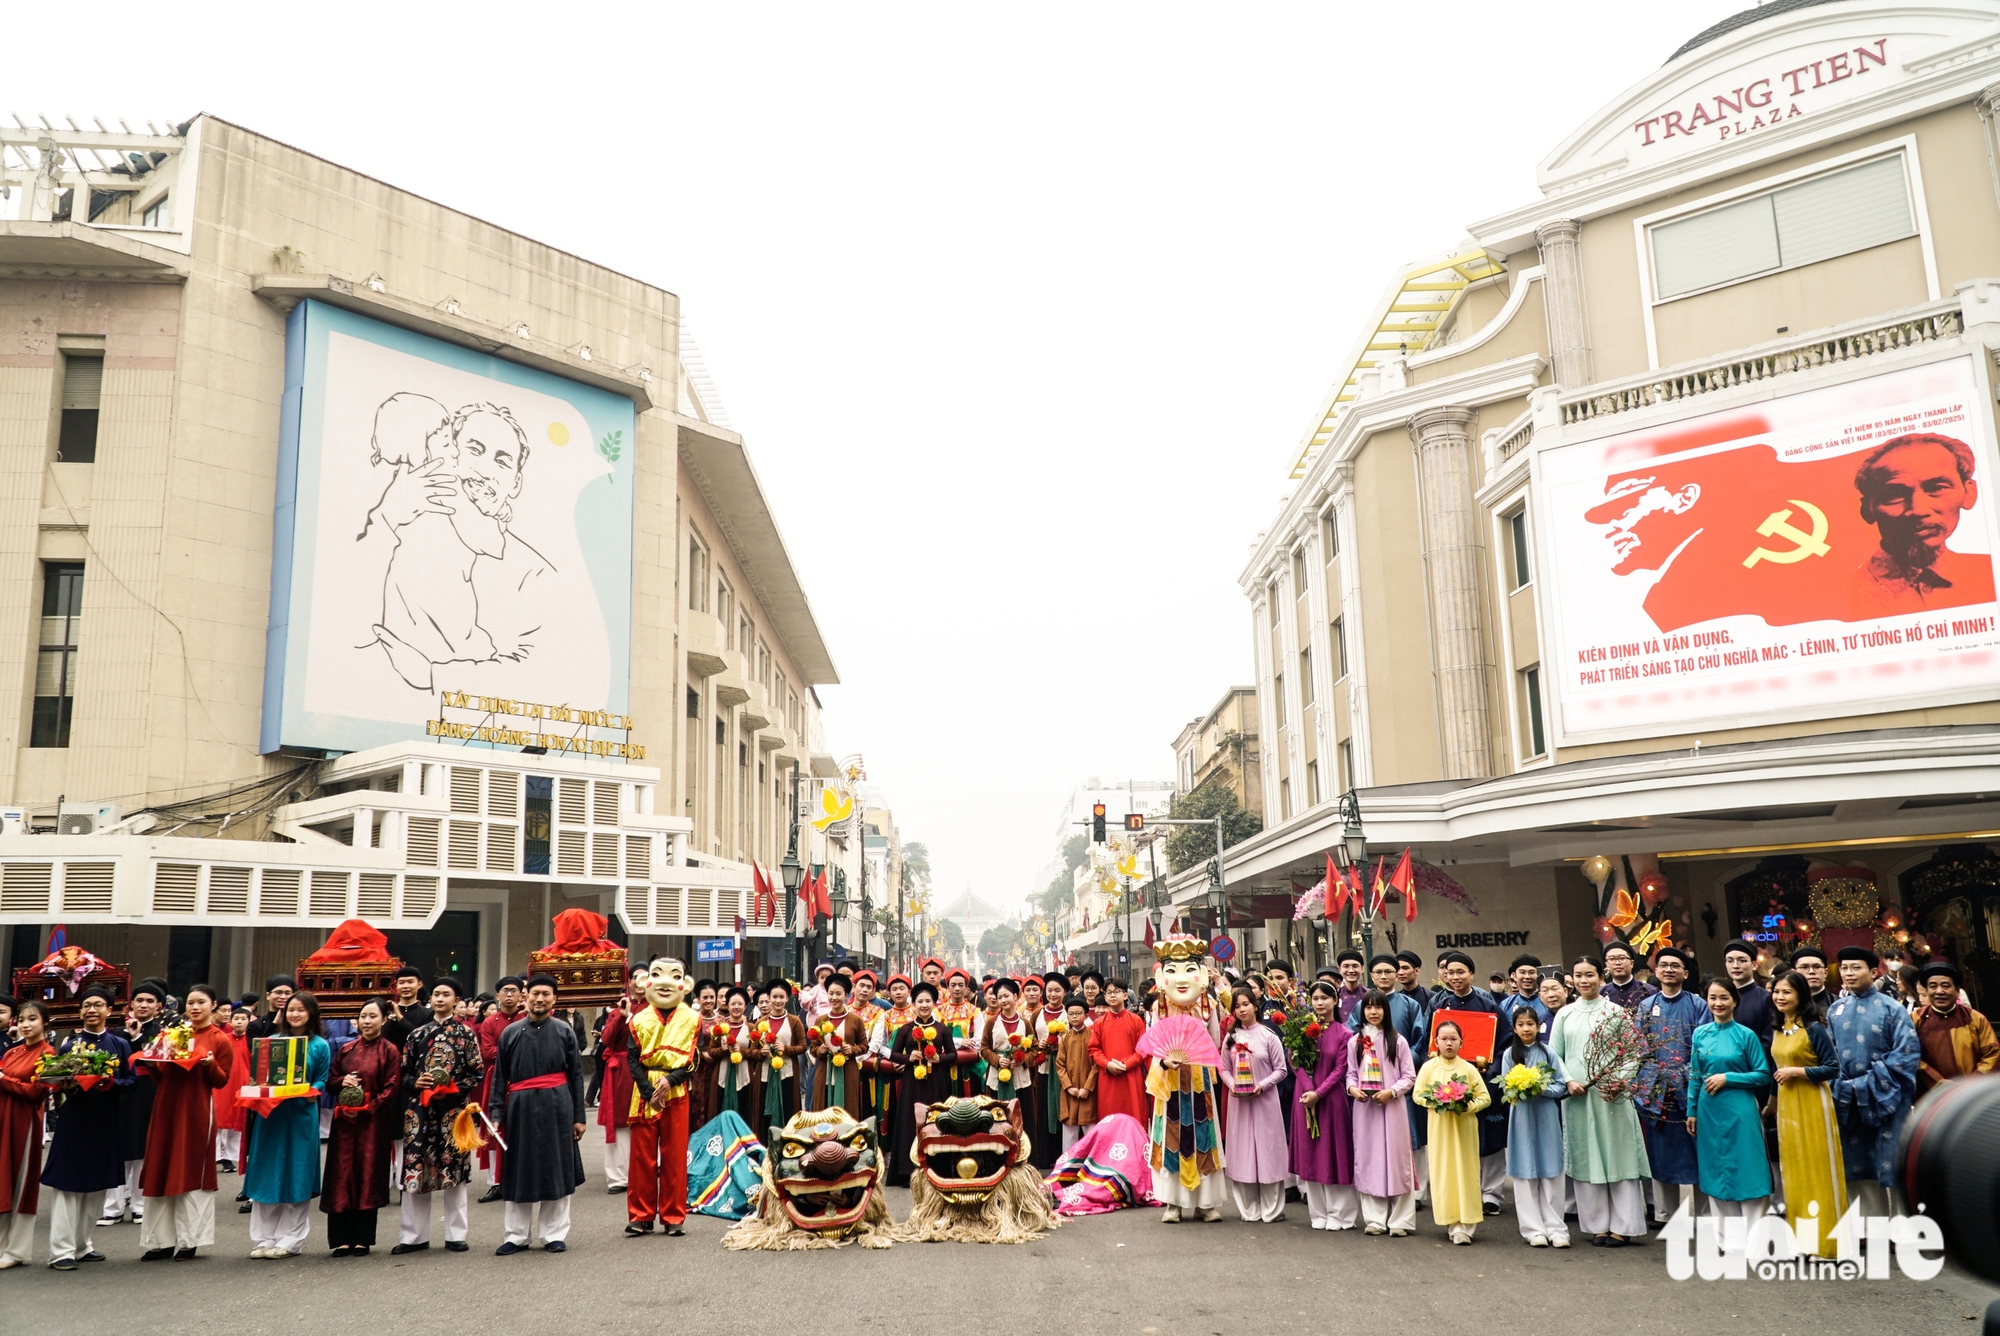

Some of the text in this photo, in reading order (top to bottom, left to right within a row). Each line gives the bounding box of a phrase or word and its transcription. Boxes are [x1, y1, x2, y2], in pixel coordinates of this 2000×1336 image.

[1634, 38, 1888, 146] TRANG TIEN
[1719, 102, 1802, 140] PLAZA
[1804, 443, 1823, 454] CỘNG
[1856, 433, 1873, 442] NAM
[1875, 424, 1916, 439] (03/02/1930
[1922, 414, 1965, 429] 03/02/2025)
[1854, 422, 1873, 433] NIỆM
[1874, 421, 1883, 429] 95
[1903, 412, 1922, 423] NGÀY
[1923, 408, 1948, 419] THÀNH
[1578, 629, 1734, 664] KIÊN ĐỊNH VÀ VẬN DỤNG,
[1580, 667, 1606, 685] PHÁT
[1608, 659, 1639, 682] TRIỂN
[1642, 660, 1671, 678] SÁNG
[1674, 657, 1695, 676] TẠO
[1698, 647, 1721, 670] CHỦ
[1723, 646, 1759, 667] NGHĨA
[1761, 643, 1789, 662] MÁC
[1800, 638, 1840, 657] LÊNIN,
[1842, 634, 1858, 650] TƯ
[1860, 625, 1902, 648] TƯỞNG
[1905, 621, 1923, 642] HỒ
[1926, 618, 1948, 640] CHÍ
[442, 689, 471, 709] XÂY
[523, 702, 544, 721] LẠI
[549, 702, 574, 722] ĐẤT
[621, 715, 634, 731] TA
[427, 716, 473, 740] ĐÀNG
[478, 724, 532, 746] HOÀNG
[571, 737, 588, 753] TO
[590, 739, 614, 759] ĐẸP
[1131, 817, 1142, 828] 17
[1435, 931, 1530, 948] BURBERRY
[1762, 914, 1786, 929] 5G
